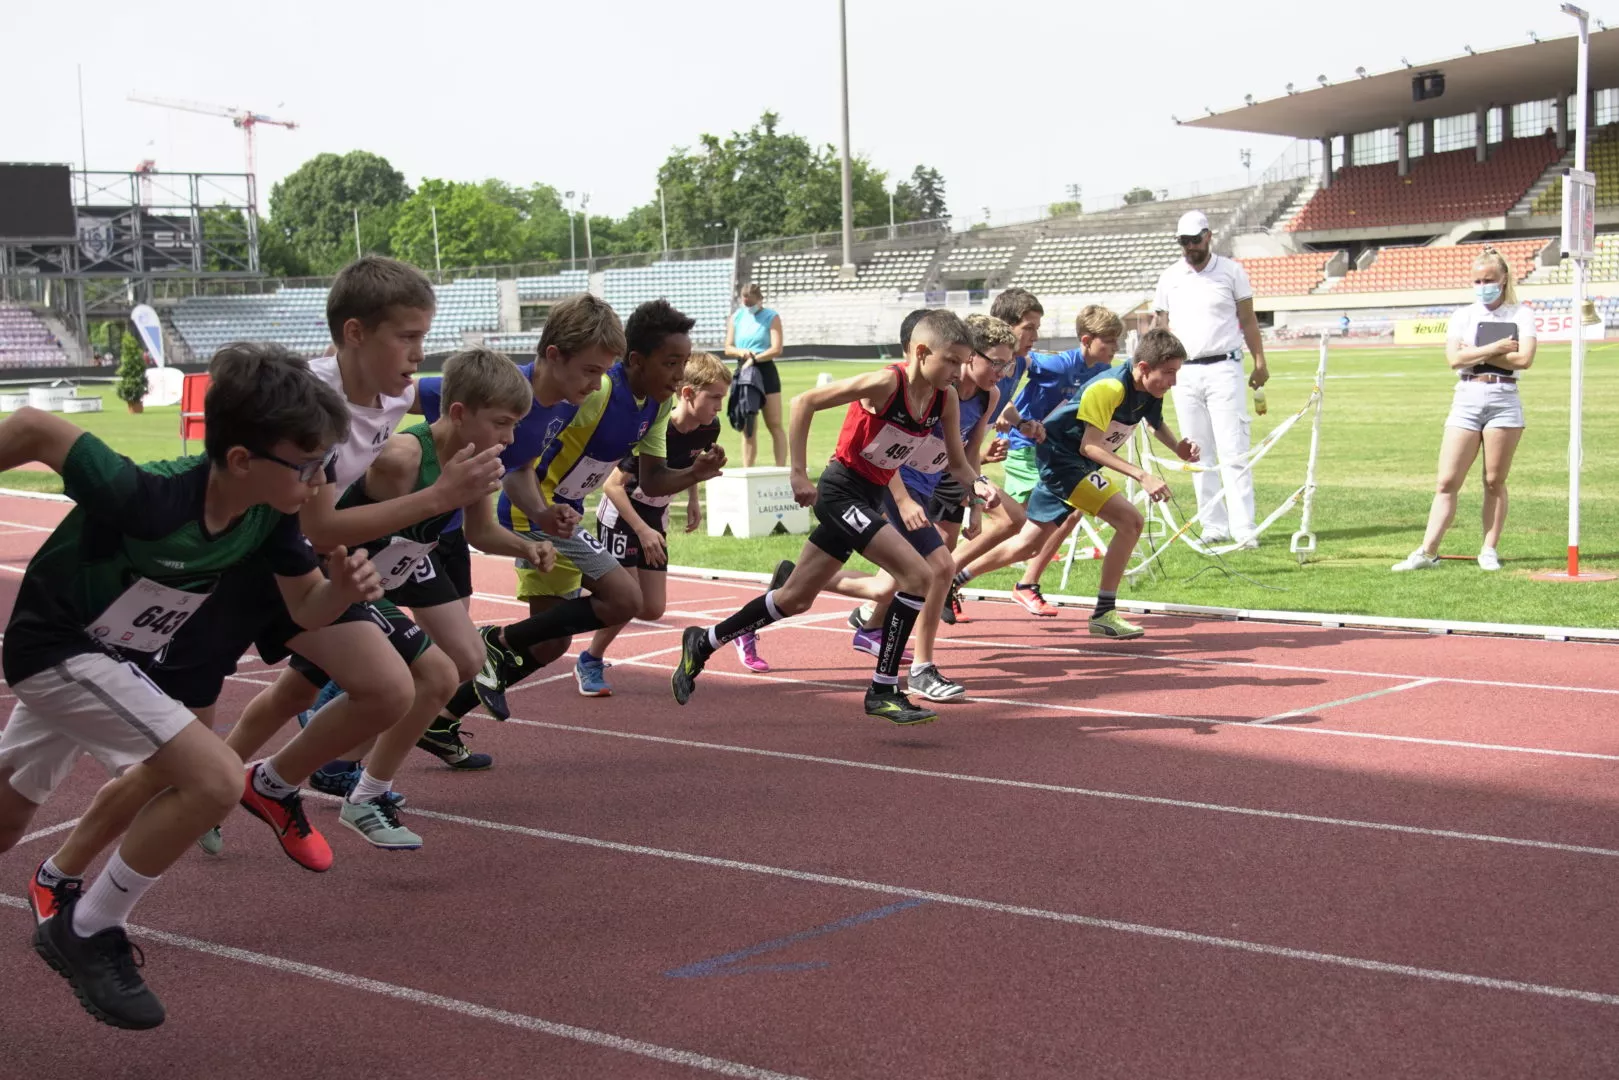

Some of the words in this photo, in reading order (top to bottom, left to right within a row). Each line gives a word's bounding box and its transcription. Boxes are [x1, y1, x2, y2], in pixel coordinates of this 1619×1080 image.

[1090, 474, 1107, 489] 2
[759, 504, 800, 514] LAUSANNE
[845, 507, 864, 528] 7
[582, 532, 603, 551] 8
[613, 536, 626, 556] 6
[132, 605, 189, 635] 643
